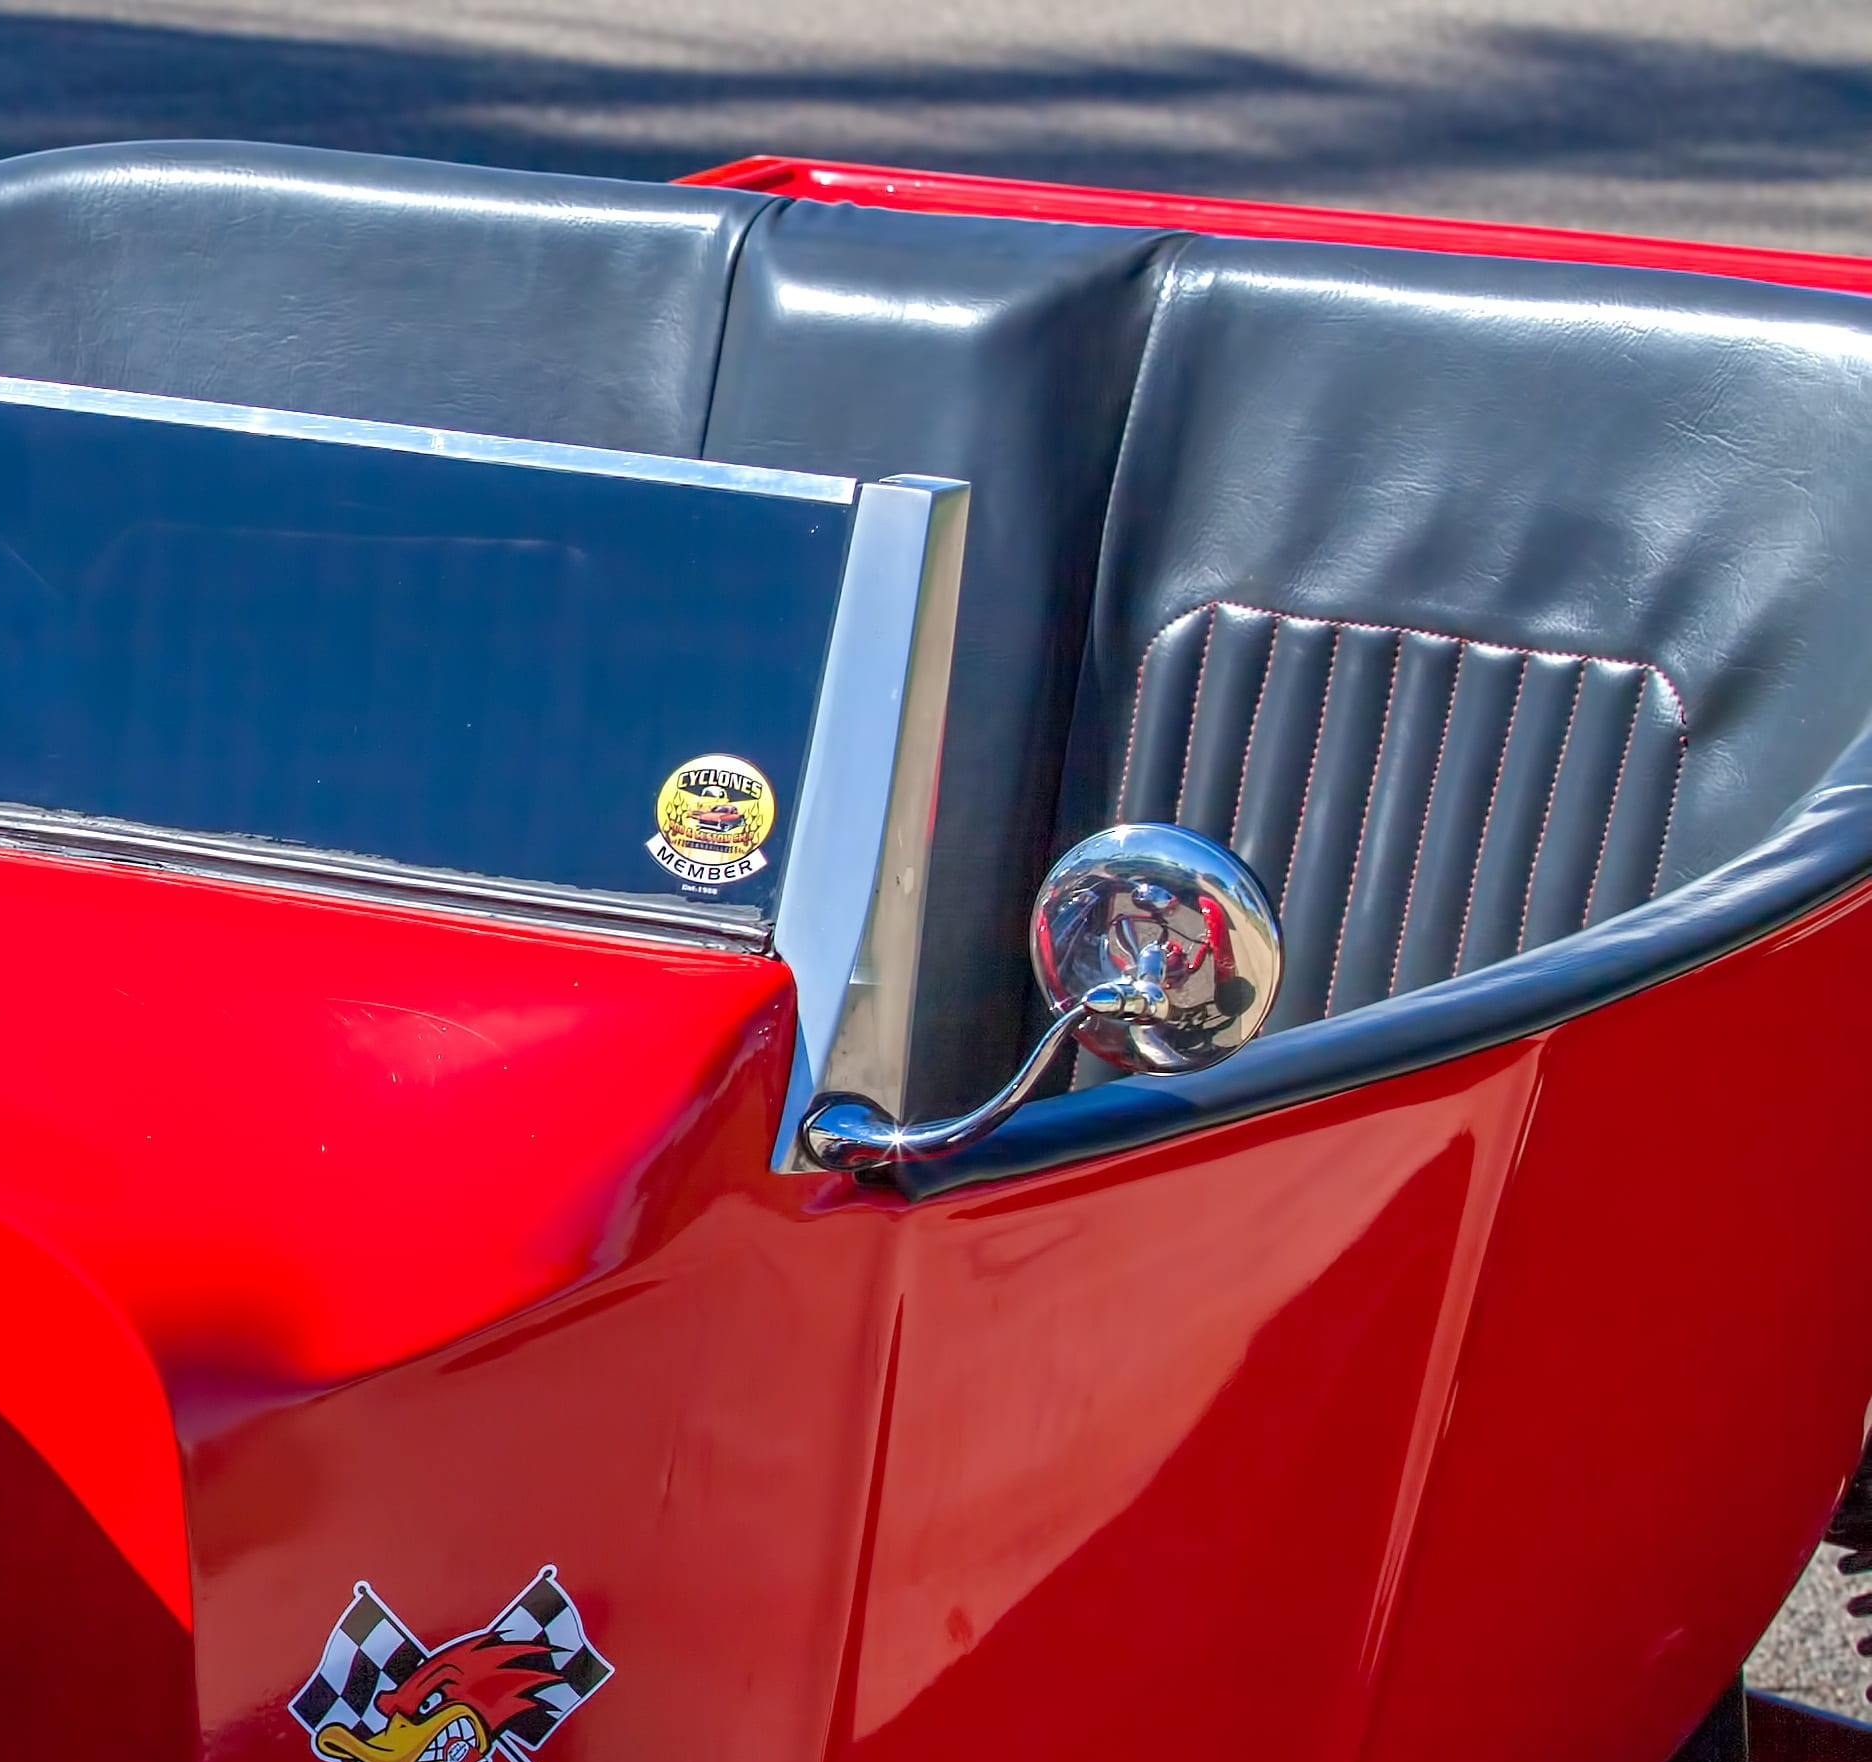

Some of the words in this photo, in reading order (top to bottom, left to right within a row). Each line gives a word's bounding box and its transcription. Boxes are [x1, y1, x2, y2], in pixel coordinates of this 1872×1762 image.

[676, 768, 763, 800] CYCLONES
[694, 830, 732, 843] CUSTOM
[656, 845, 753, 880] MEMBER
